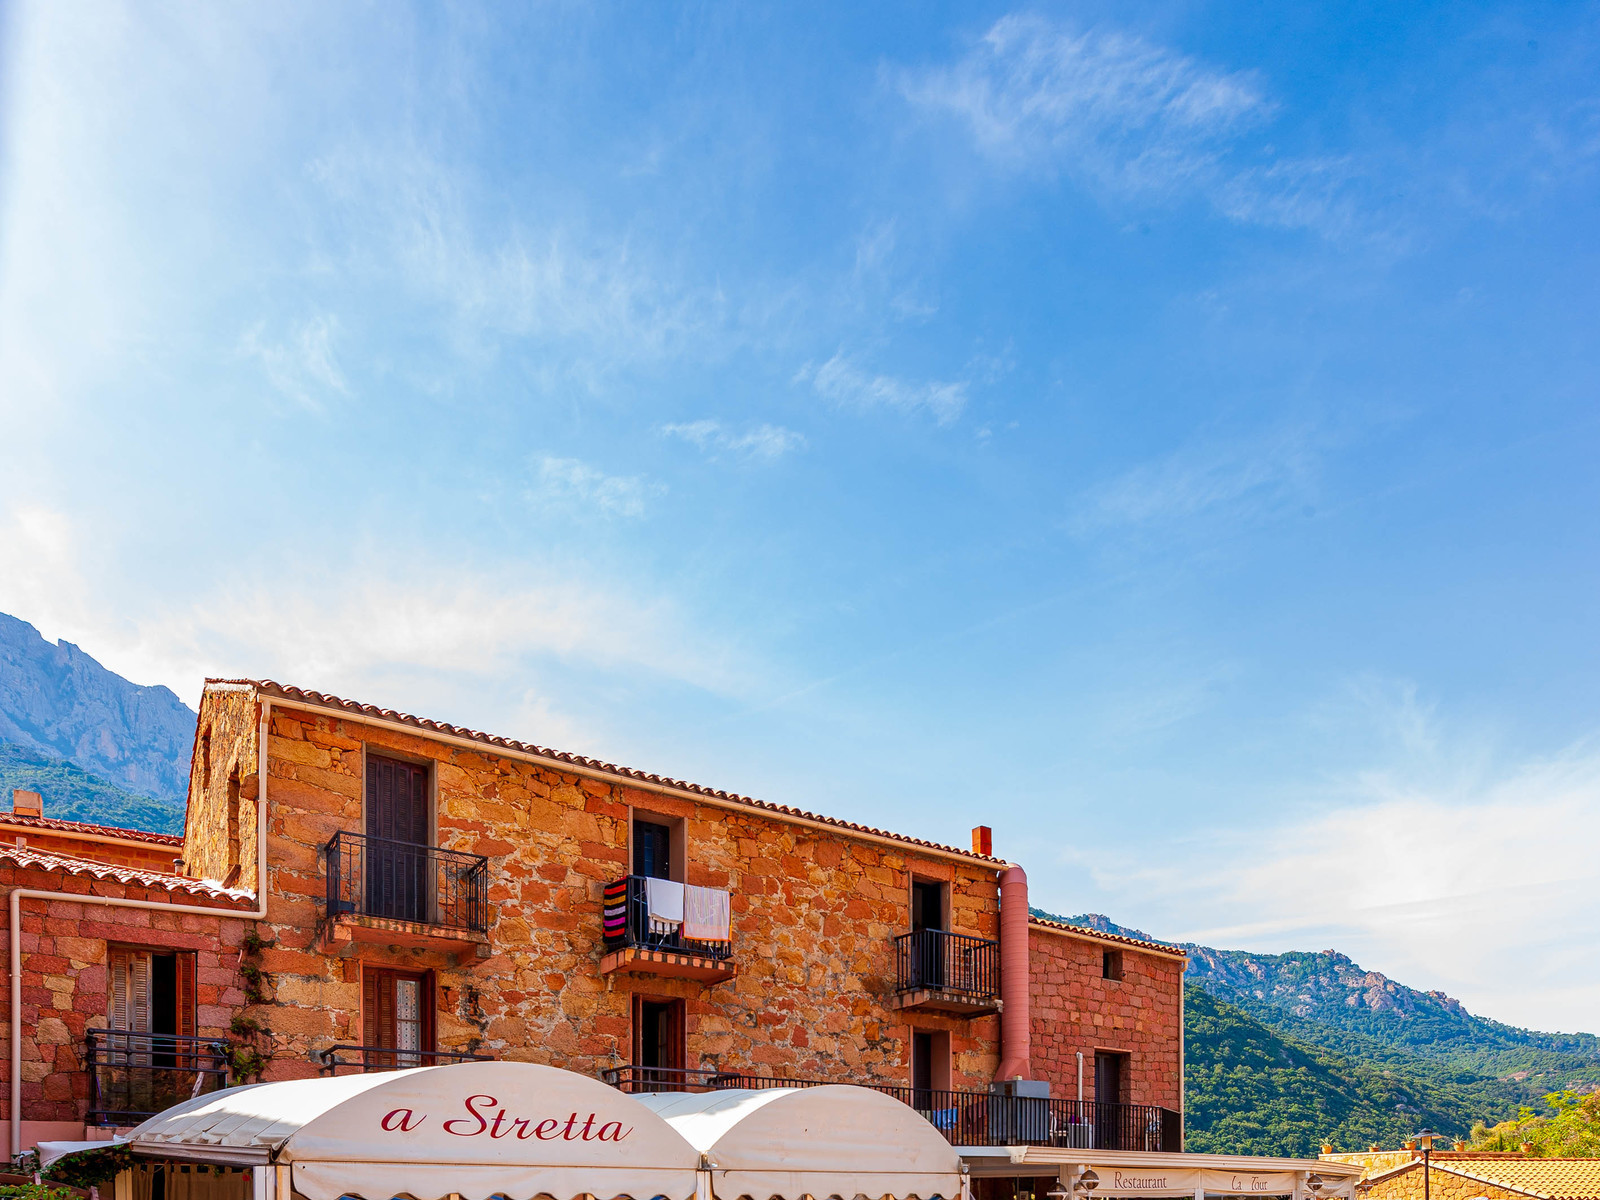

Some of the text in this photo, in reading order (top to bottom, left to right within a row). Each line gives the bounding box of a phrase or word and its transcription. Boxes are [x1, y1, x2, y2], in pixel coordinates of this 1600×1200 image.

[381, 1094, 634, 1142] a Stretta
[1114, 1171, 1167, 1190] Restaurant
[1231, 1175, 1268, 1191] La Tour
